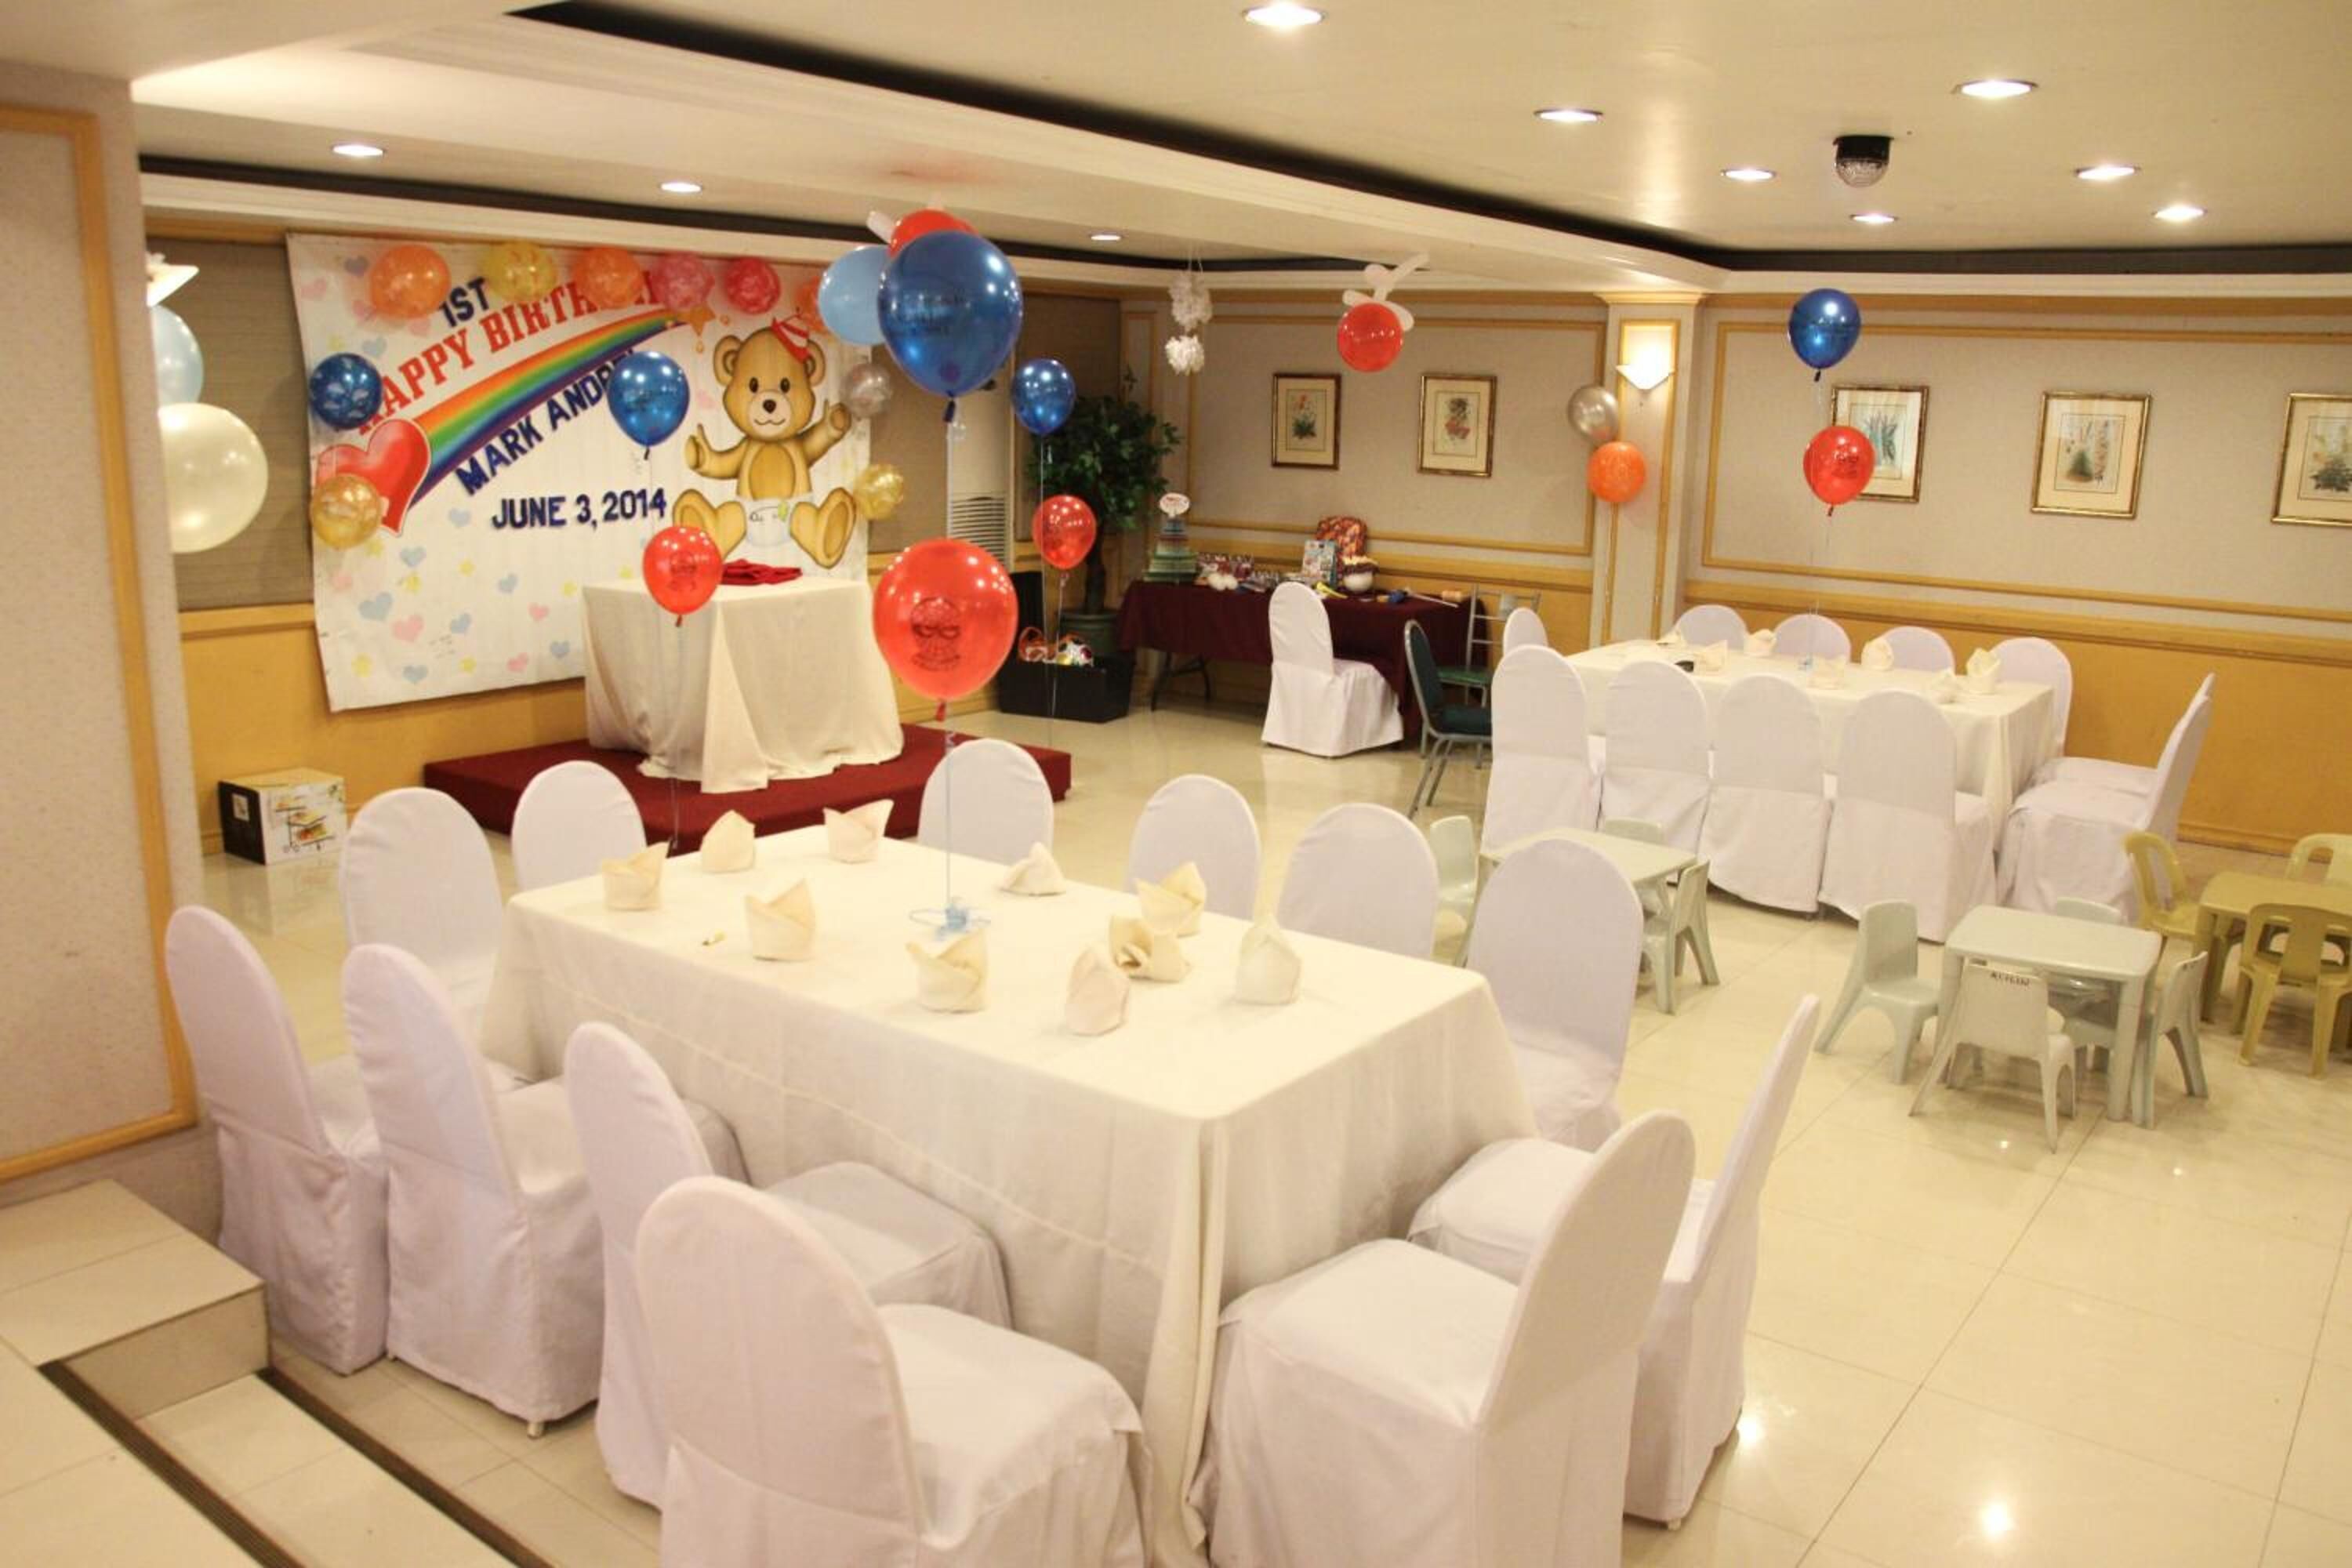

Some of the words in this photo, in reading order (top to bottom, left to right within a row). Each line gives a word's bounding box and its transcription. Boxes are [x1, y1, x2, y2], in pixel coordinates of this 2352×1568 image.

[359, 327, 475, 435] APPY
[455, 416, 544, 495] MARK
[492, 496, 567, 529] JUNE
[602, 488, 666, 523] 2014
